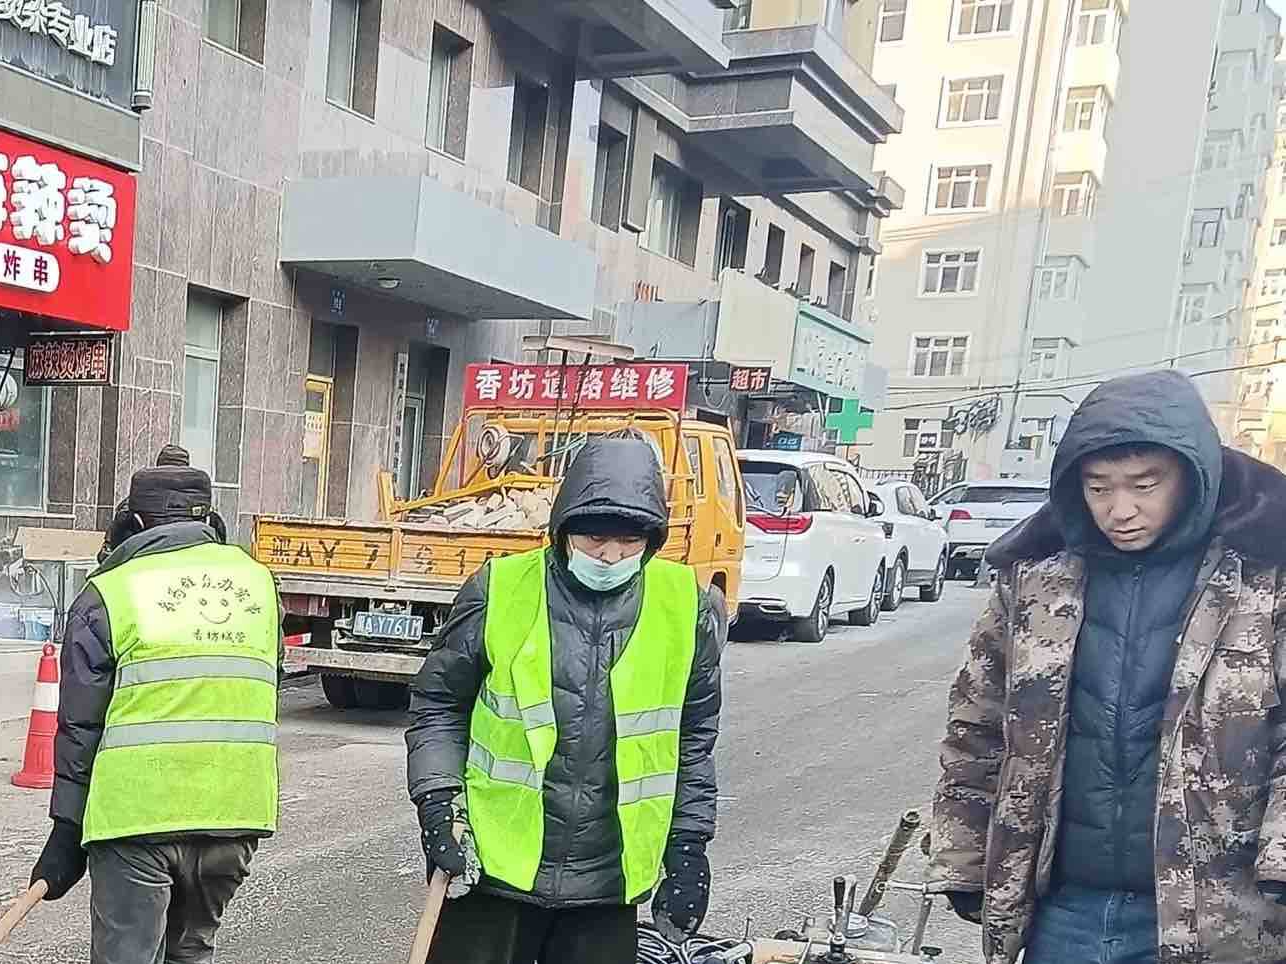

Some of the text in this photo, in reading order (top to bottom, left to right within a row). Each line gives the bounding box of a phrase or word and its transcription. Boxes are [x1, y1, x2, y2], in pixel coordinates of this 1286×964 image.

[2, 249, 50, 287] 炸串
[475, 368, 676, 401] 香坊道路维修
[730, 368, 768, 391] 超市
